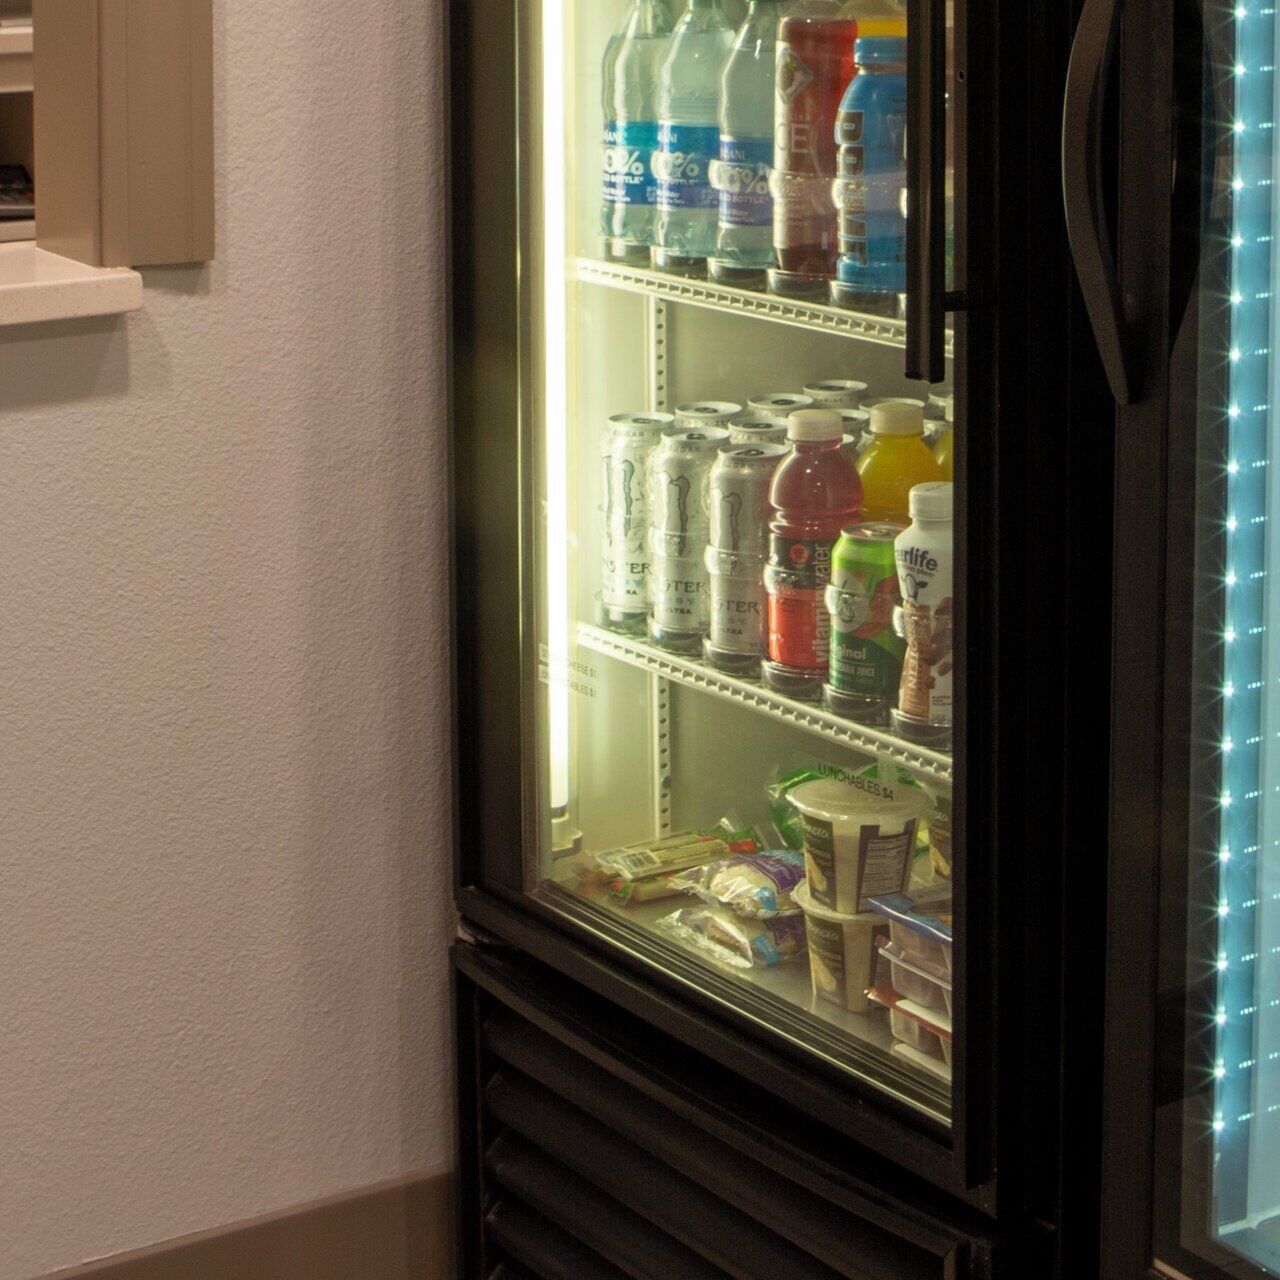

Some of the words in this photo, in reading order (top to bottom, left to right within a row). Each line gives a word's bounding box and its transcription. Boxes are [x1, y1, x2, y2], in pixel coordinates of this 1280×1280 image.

[812, 544, 831, 662] vitaminwater
[818, 761, 881, 798] LUNCHABLES
[882, 786, 894, 802] $4
